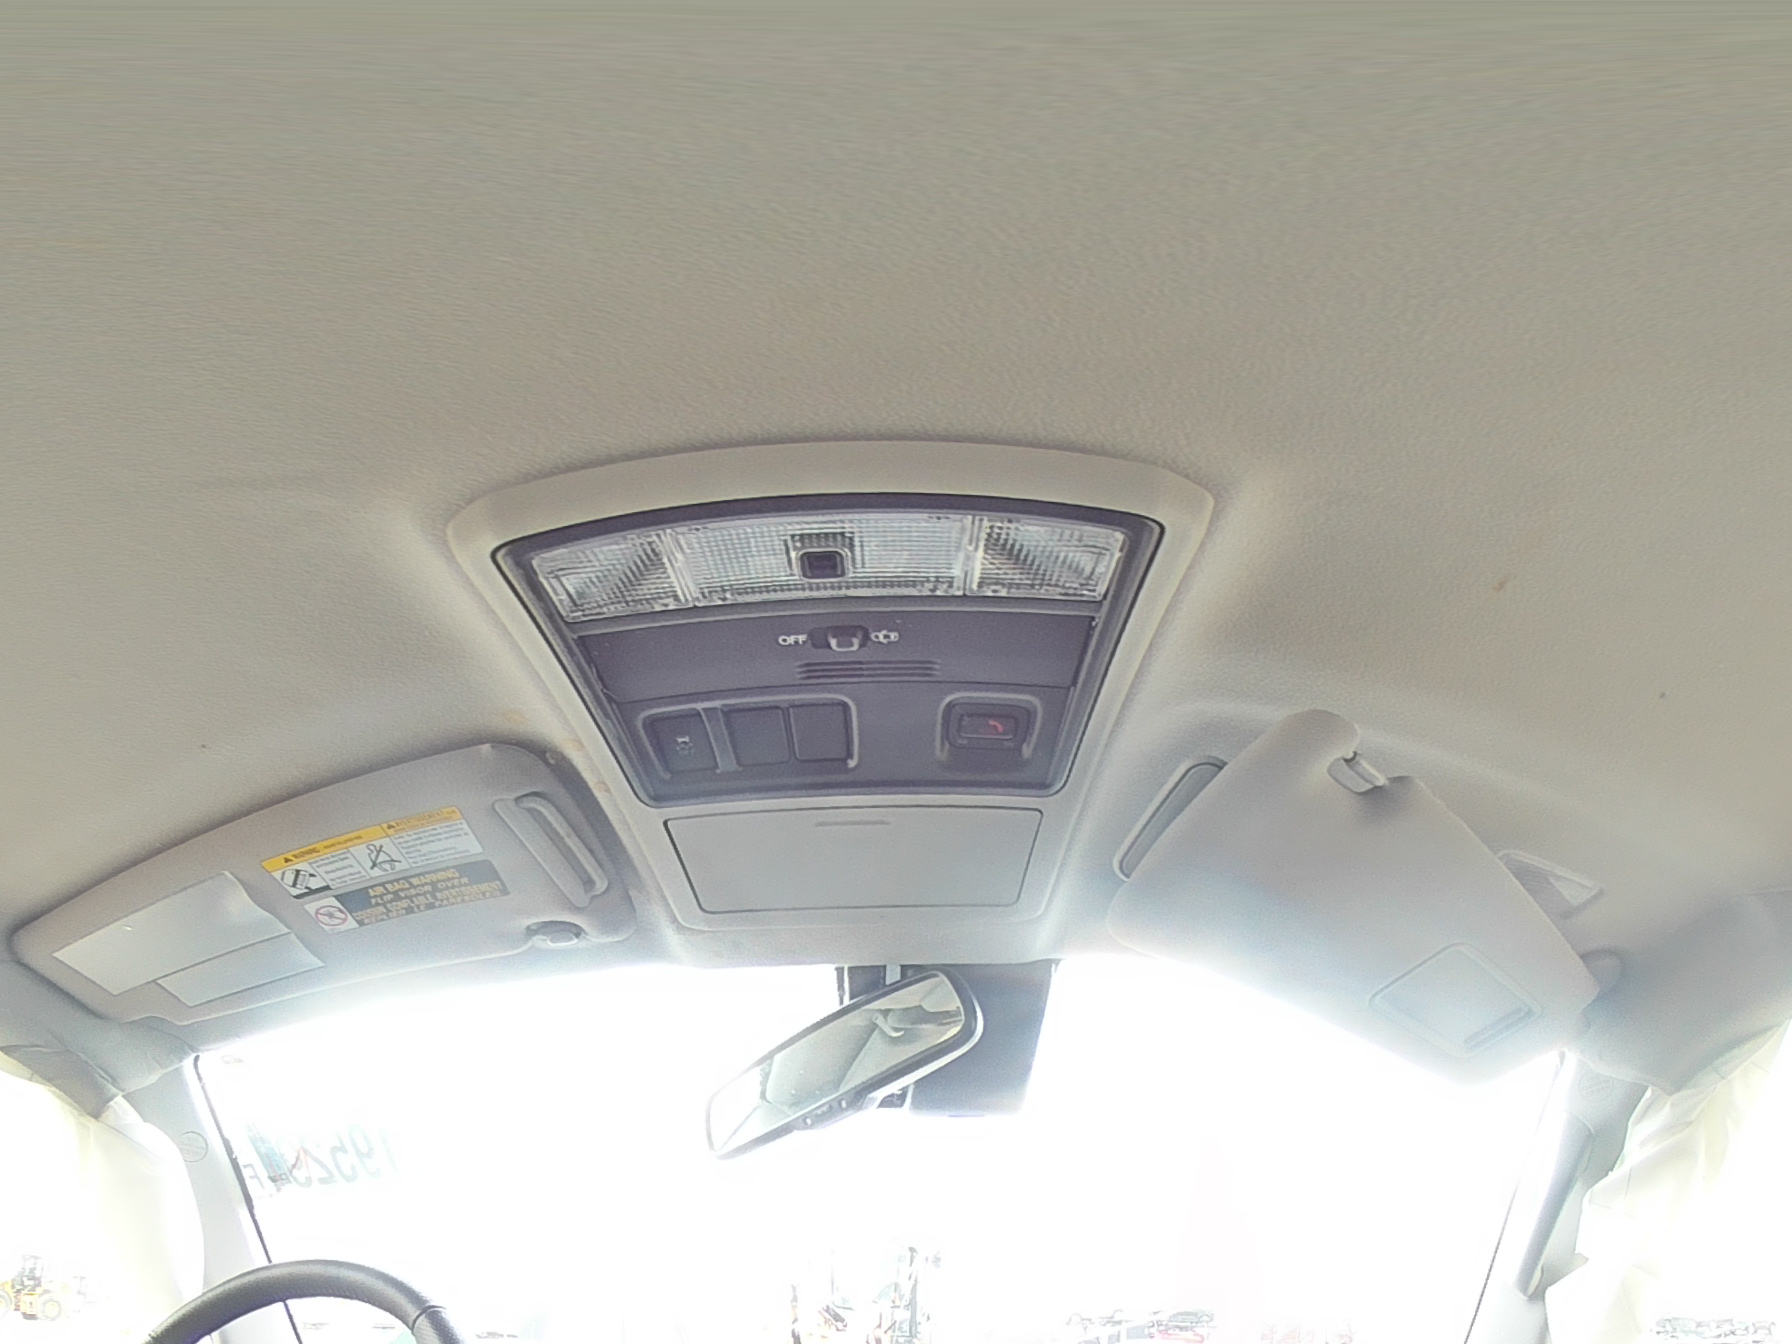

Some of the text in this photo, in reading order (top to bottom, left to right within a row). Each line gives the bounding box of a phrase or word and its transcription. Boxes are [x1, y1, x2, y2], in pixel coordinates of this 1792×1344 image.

[778, 633, 808, 645] OFF
[399, 885, 432, 898] VISOR
[437, 877, 470, 889] OVER
